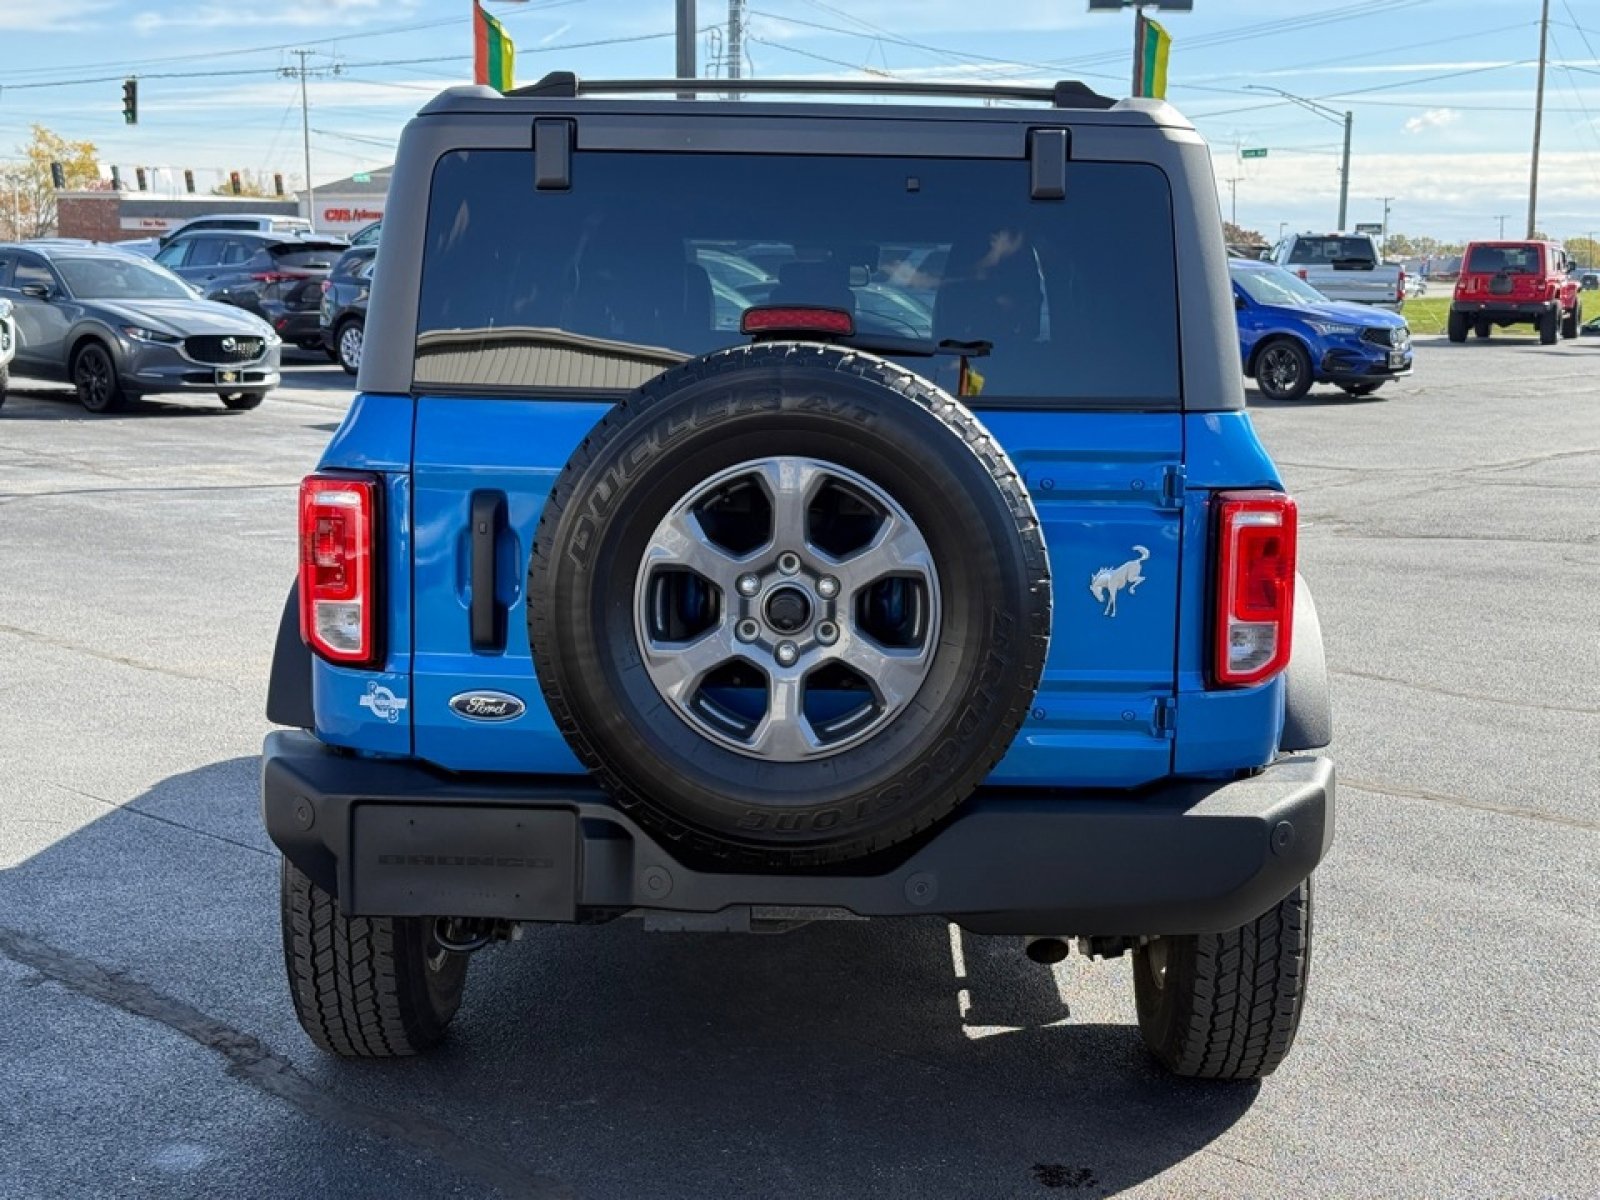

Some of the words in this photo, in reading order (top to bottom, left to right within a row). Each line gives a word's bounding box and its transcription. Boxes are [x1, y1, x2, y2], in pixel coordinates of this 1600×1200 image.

[465, 696, 507, 715] Ford
[737, 605, 1014, 833] BRIDGESTONE
[378, 854, 554, 868] BRONCO
